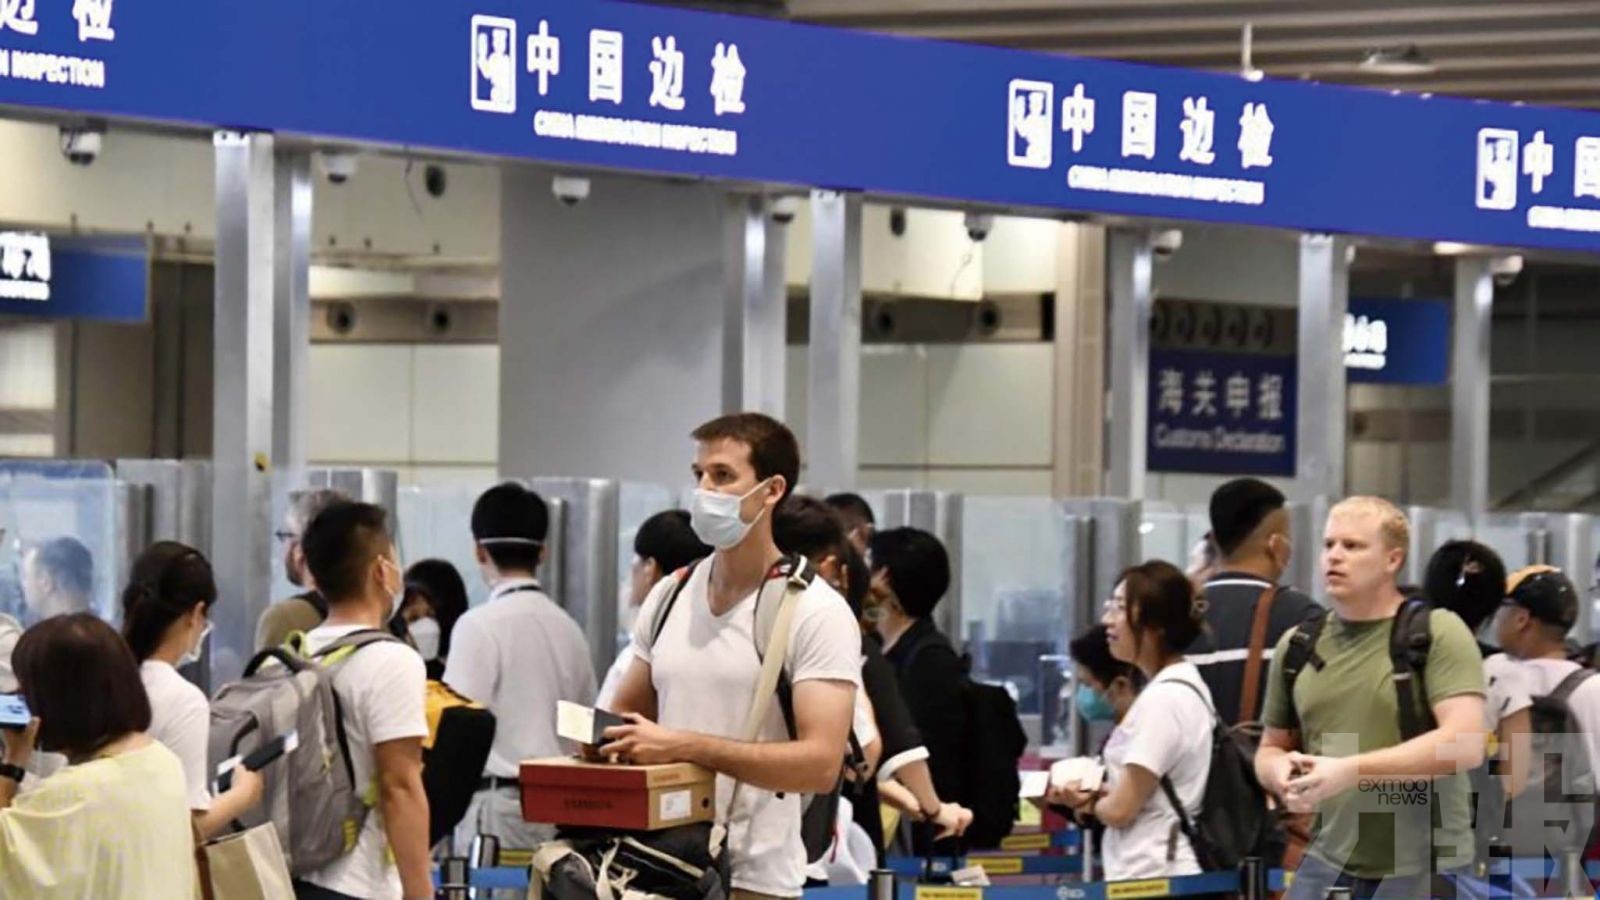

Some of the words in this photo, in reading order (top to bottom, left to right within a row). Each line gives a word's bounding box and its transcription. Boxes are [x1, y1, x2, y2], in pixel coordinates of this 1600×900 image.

[527, 20, 746, 115] 中国边检
[1062, 84, 1273, 168] 中国边检
[1158, 368, 1283, 419] 海关申报
